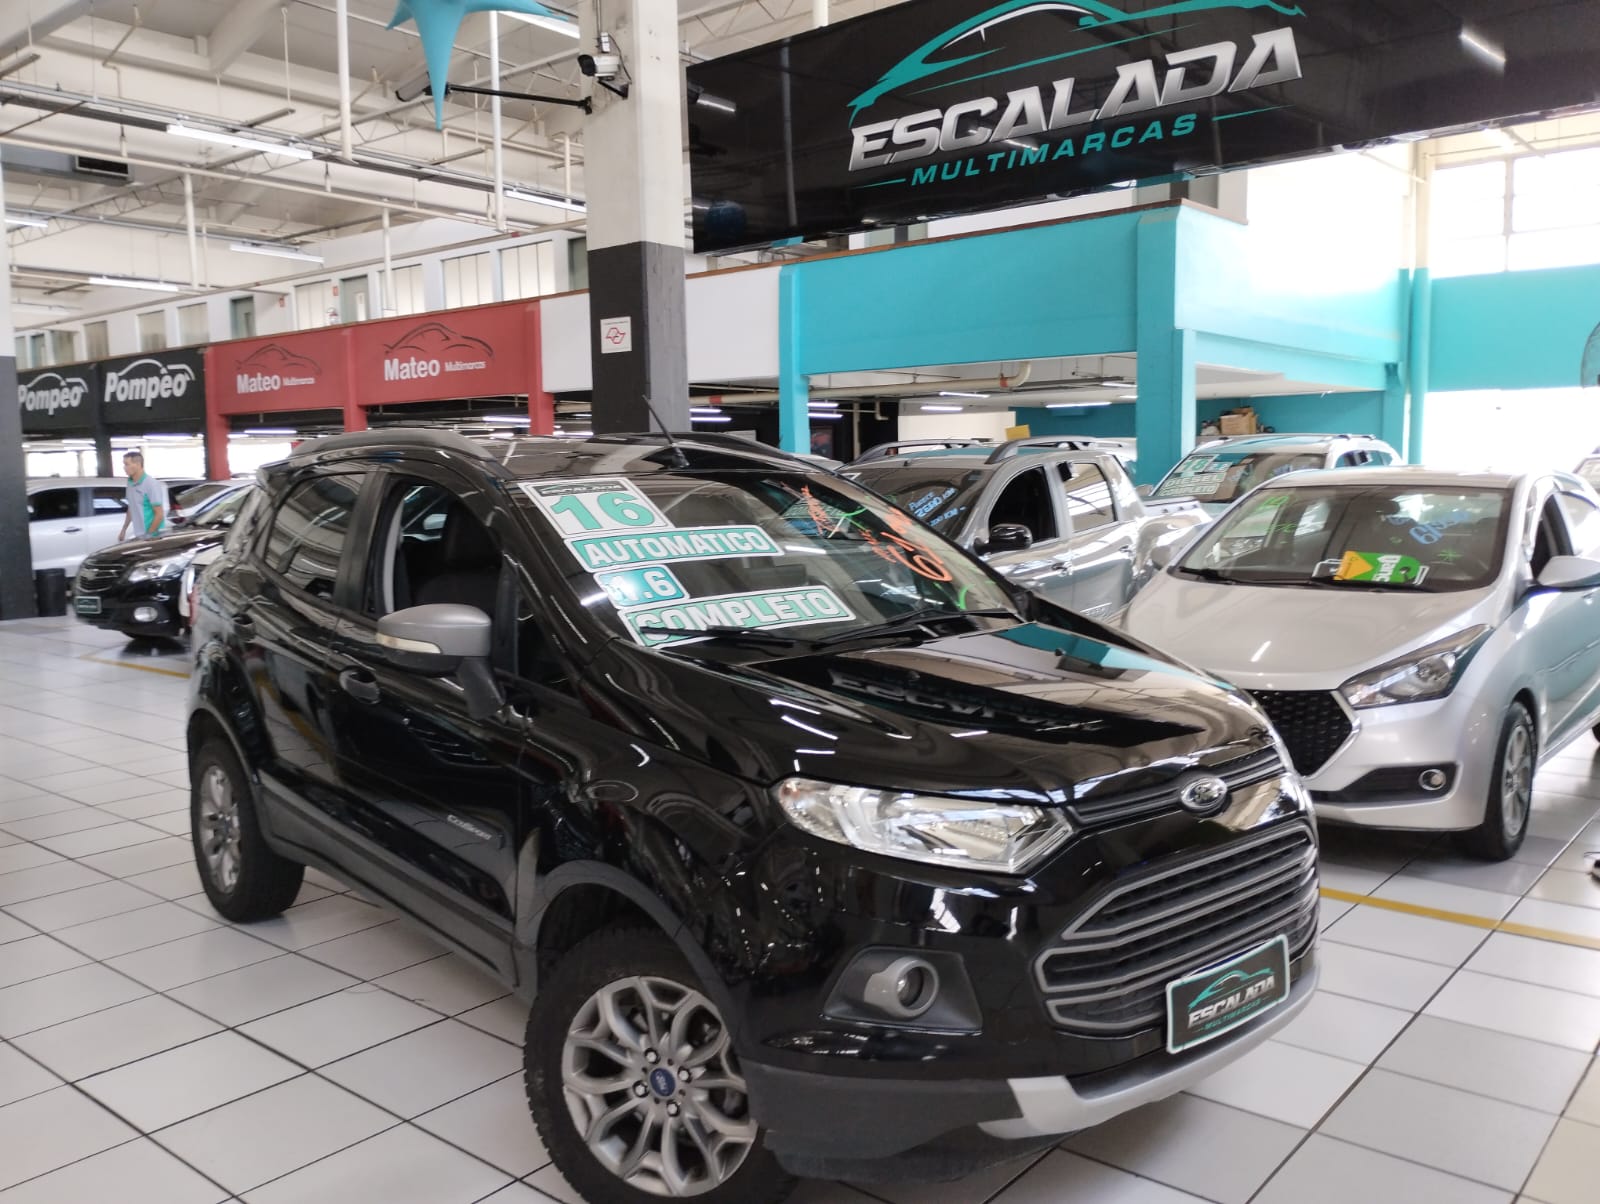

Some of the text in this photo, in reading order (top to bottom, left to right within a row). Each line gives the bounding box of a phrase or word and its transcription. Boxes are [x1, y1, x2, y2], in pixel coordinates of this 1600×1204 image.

[848, 26, 1302, 171] ESCALADA
[911, 113, 1197, 186] MULTIMARCAS
[237, 372, 281, 394] Mateo
[384, 357, 440, 381] Mateo
[550, 491, 656, 531] 16
[582, 531, 772, 567] AUTOMÁTICO
[635, 591, 842, 642] COMPLETO
[1187, 975, 1276, 1029] ESCALADA
